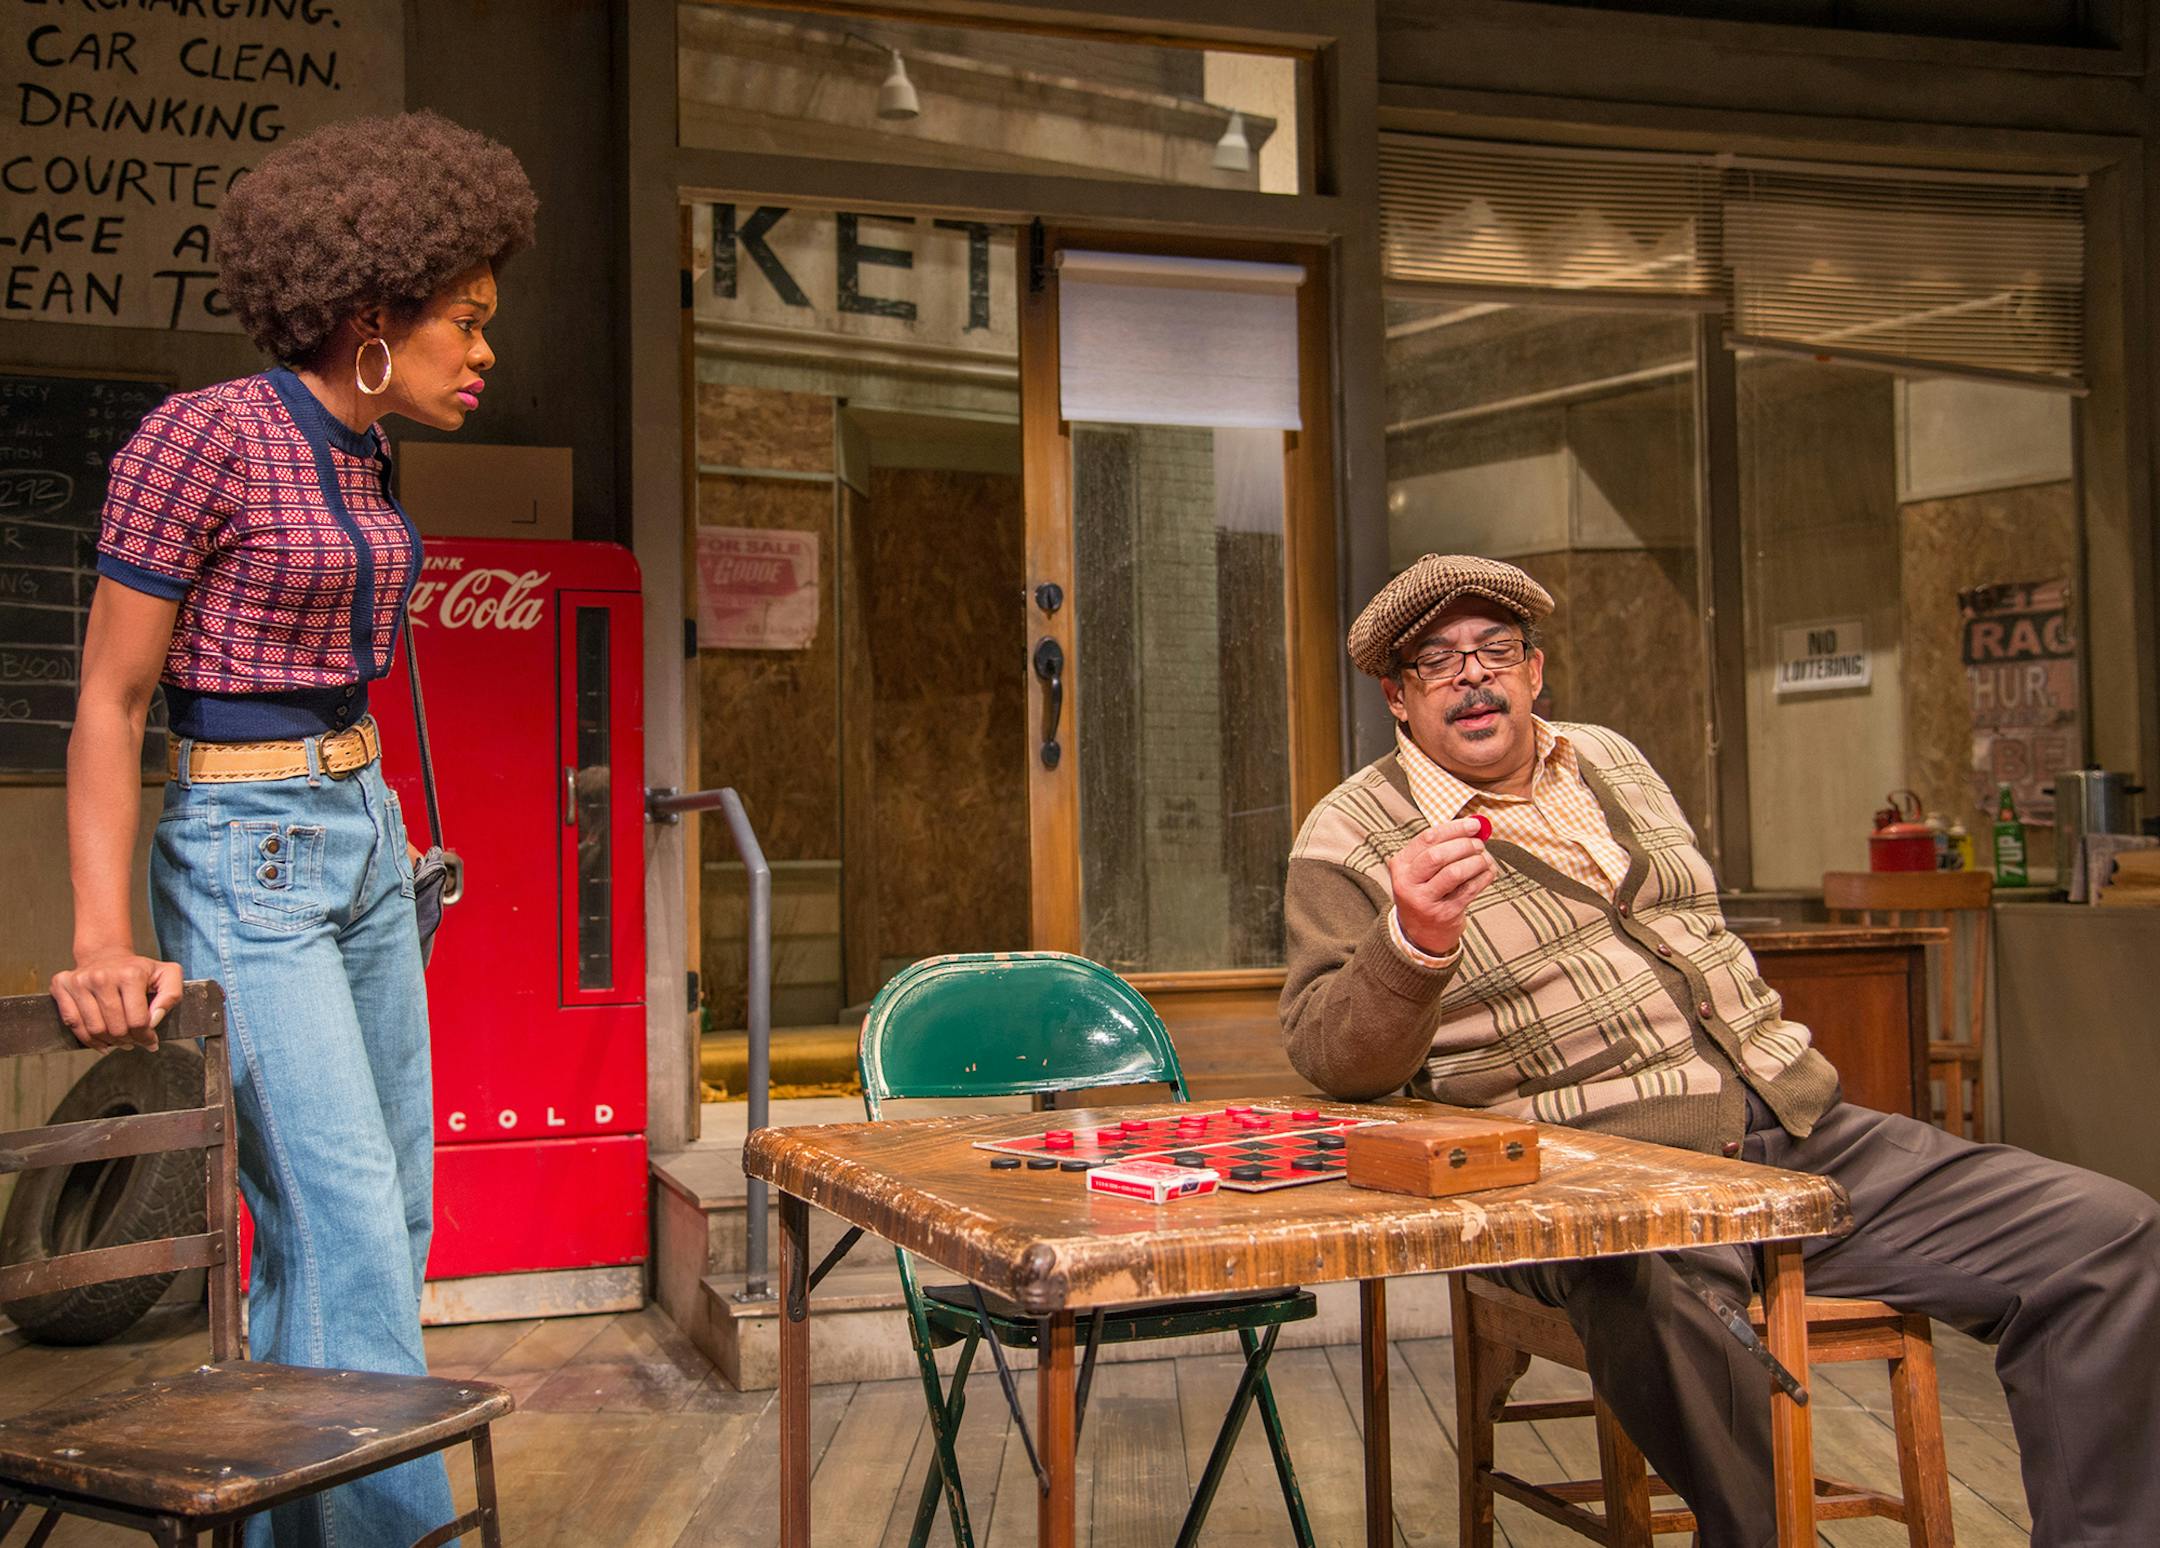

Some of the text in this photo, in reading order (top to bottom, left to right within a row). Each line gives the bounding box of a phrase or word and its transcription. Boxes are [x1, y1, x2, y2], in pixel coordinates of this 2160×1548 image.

[27, 24, 341, 90] CAR CLEAN.
[18, 82, 285, 143] DRINKING
[0, 211, 125, 255] ACE
[1807, 629, 1837, 655] NO
[1782, 655, 1864, 683] LOITERING
[448, 1104, 614, 1132] COLD
